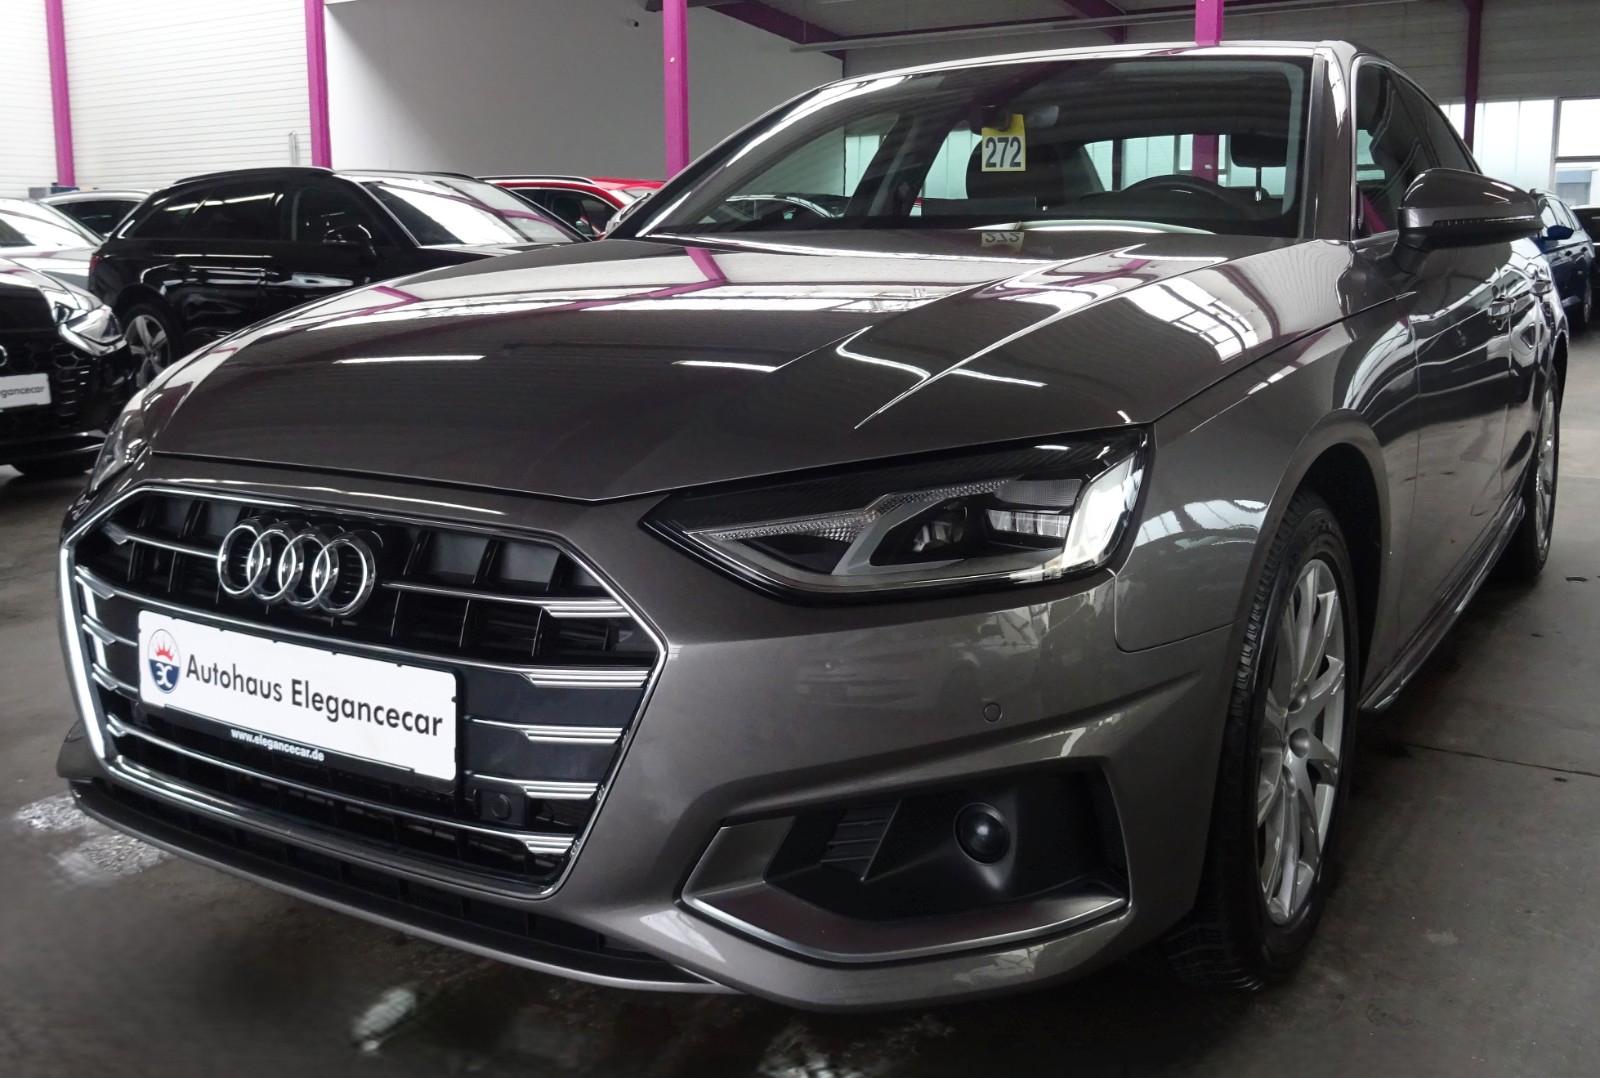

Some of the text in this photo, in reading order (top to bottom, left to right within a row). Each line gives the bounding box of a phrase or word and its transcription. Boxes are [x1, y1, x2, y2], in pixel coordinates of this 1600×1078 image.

[985, 136, 1022, 168] 272
[186, 654, 443, 736] Autohaus Elegancecar
[230, 728, 325, 762] www.elegancecar.de
